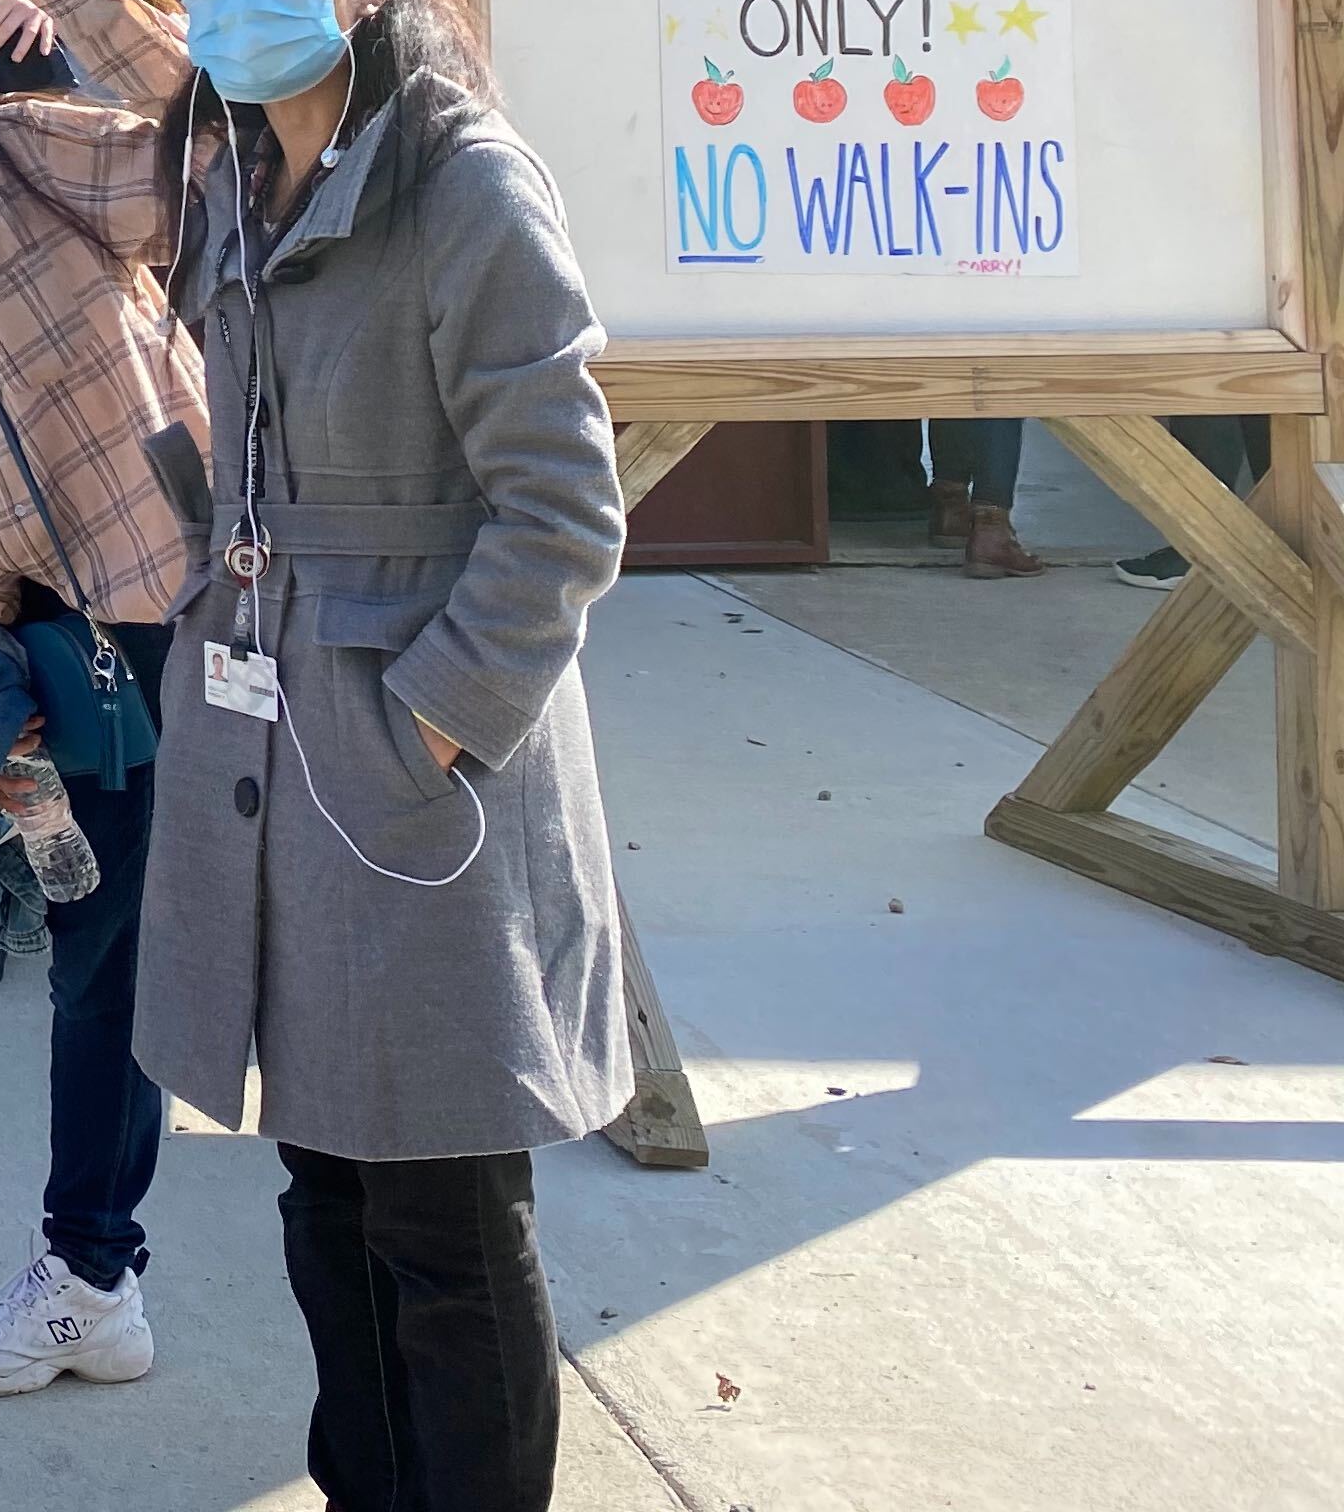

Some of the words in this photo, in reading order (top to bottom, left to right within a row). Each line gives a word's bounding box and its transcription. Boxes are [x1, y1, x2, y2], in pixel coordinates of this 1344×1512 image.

[674, 143, 767, 254] NO
[786, 139, 1066, 257] WALK-INS
[46, 1317, 82, 1344] N
